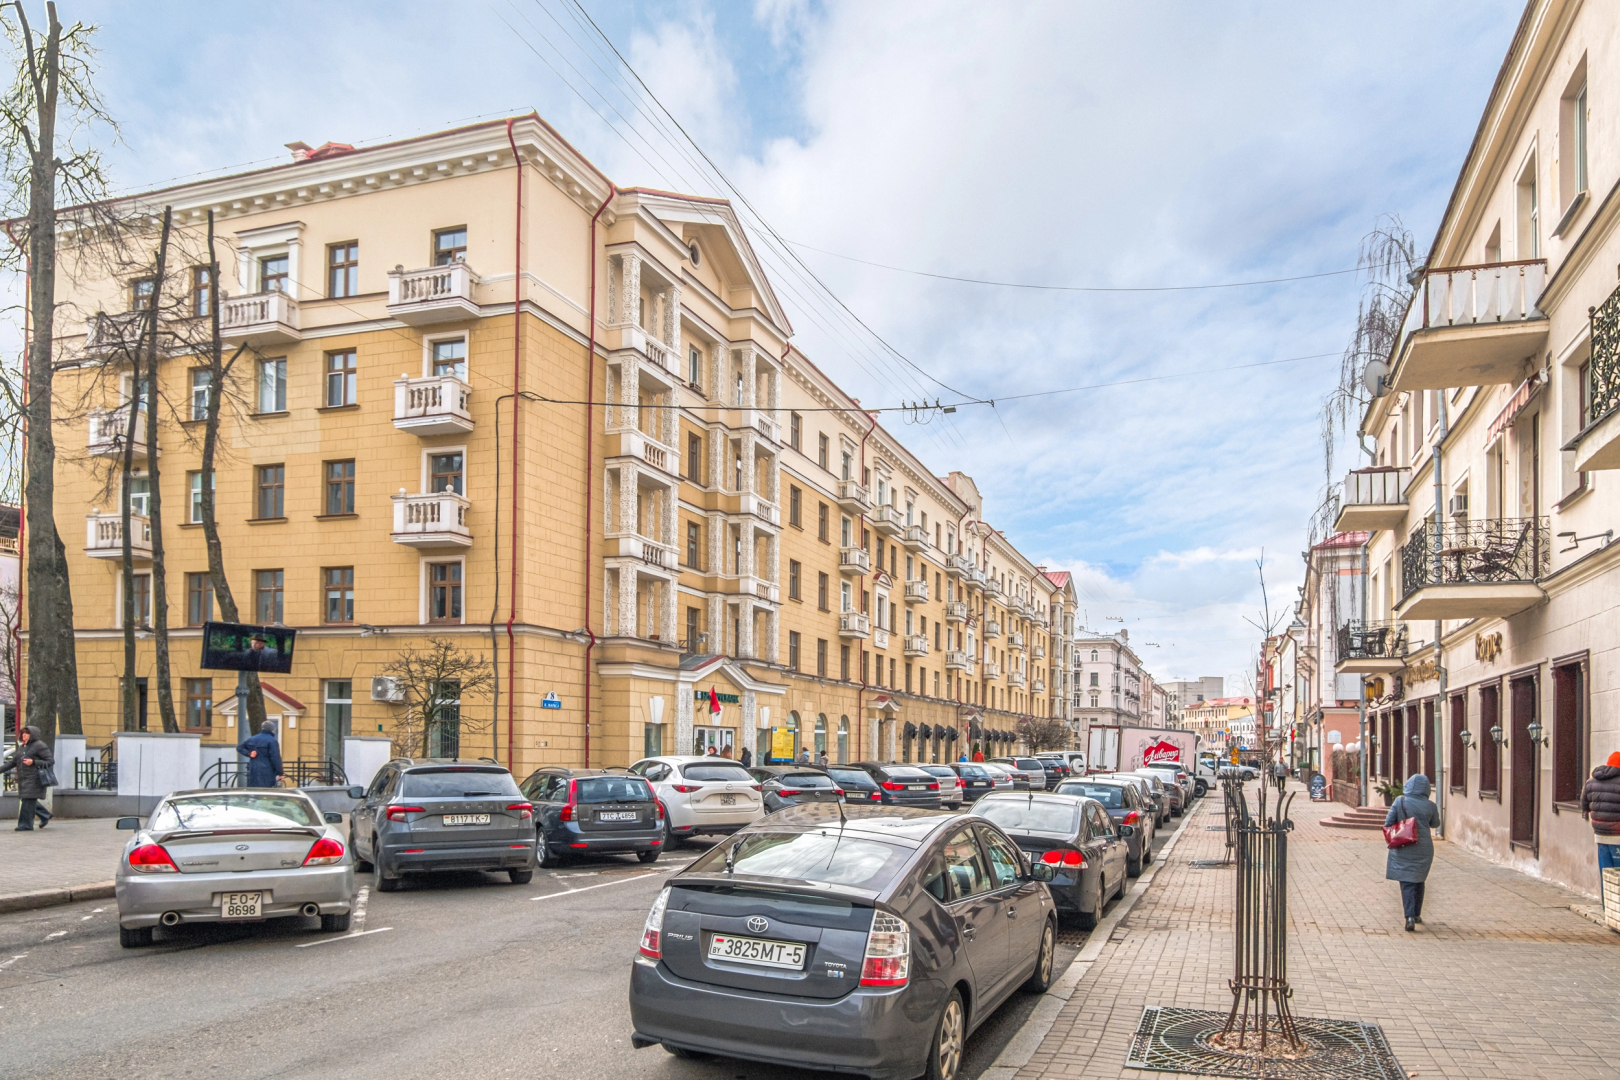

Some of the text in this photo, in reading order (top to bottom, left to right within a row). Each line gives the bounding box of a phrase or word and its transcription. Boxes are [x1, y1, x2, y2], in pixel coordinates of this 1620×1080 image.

[550, 692, 555, 700] 8
[228, 904, 256, 916] 8698
[667, 932, 694, 941] PRIUS
[724, 939, 803, 964] 3825MT-5
[824, 961, 847, 969] TOYOTA
